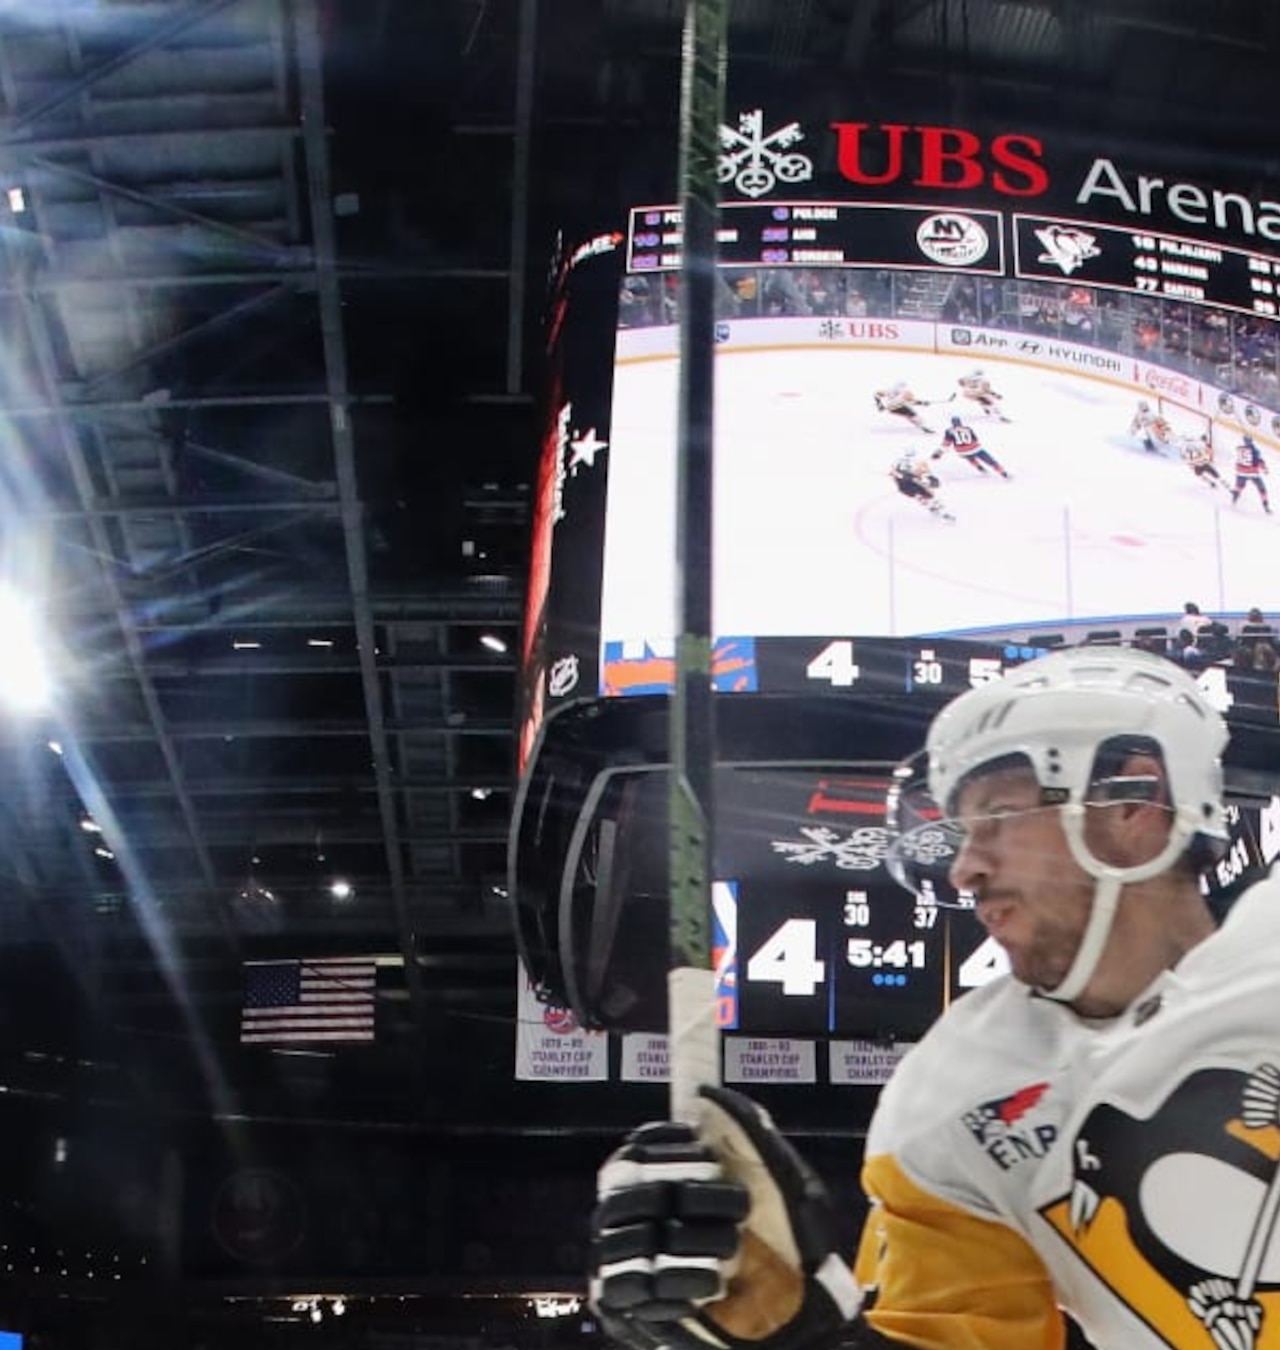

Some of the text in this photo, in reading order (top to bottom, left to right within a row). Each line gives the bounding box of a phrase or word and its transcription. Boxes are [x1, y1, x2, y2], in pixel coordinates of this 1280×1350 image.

[829, 121, 1050, 197] UBS
[849, 322, 900, 340] UBS
[1048, 345, 1122, 373] HYUNDAI
[806, 640, 860, 686] 4
[913, 661, 943, 684] 30
[843, 904, 870, 927] 30
[913, 907, 938, 929] 37
[748, 918, 826, 996] 4
[846, 937, 926, 969] 5:41
